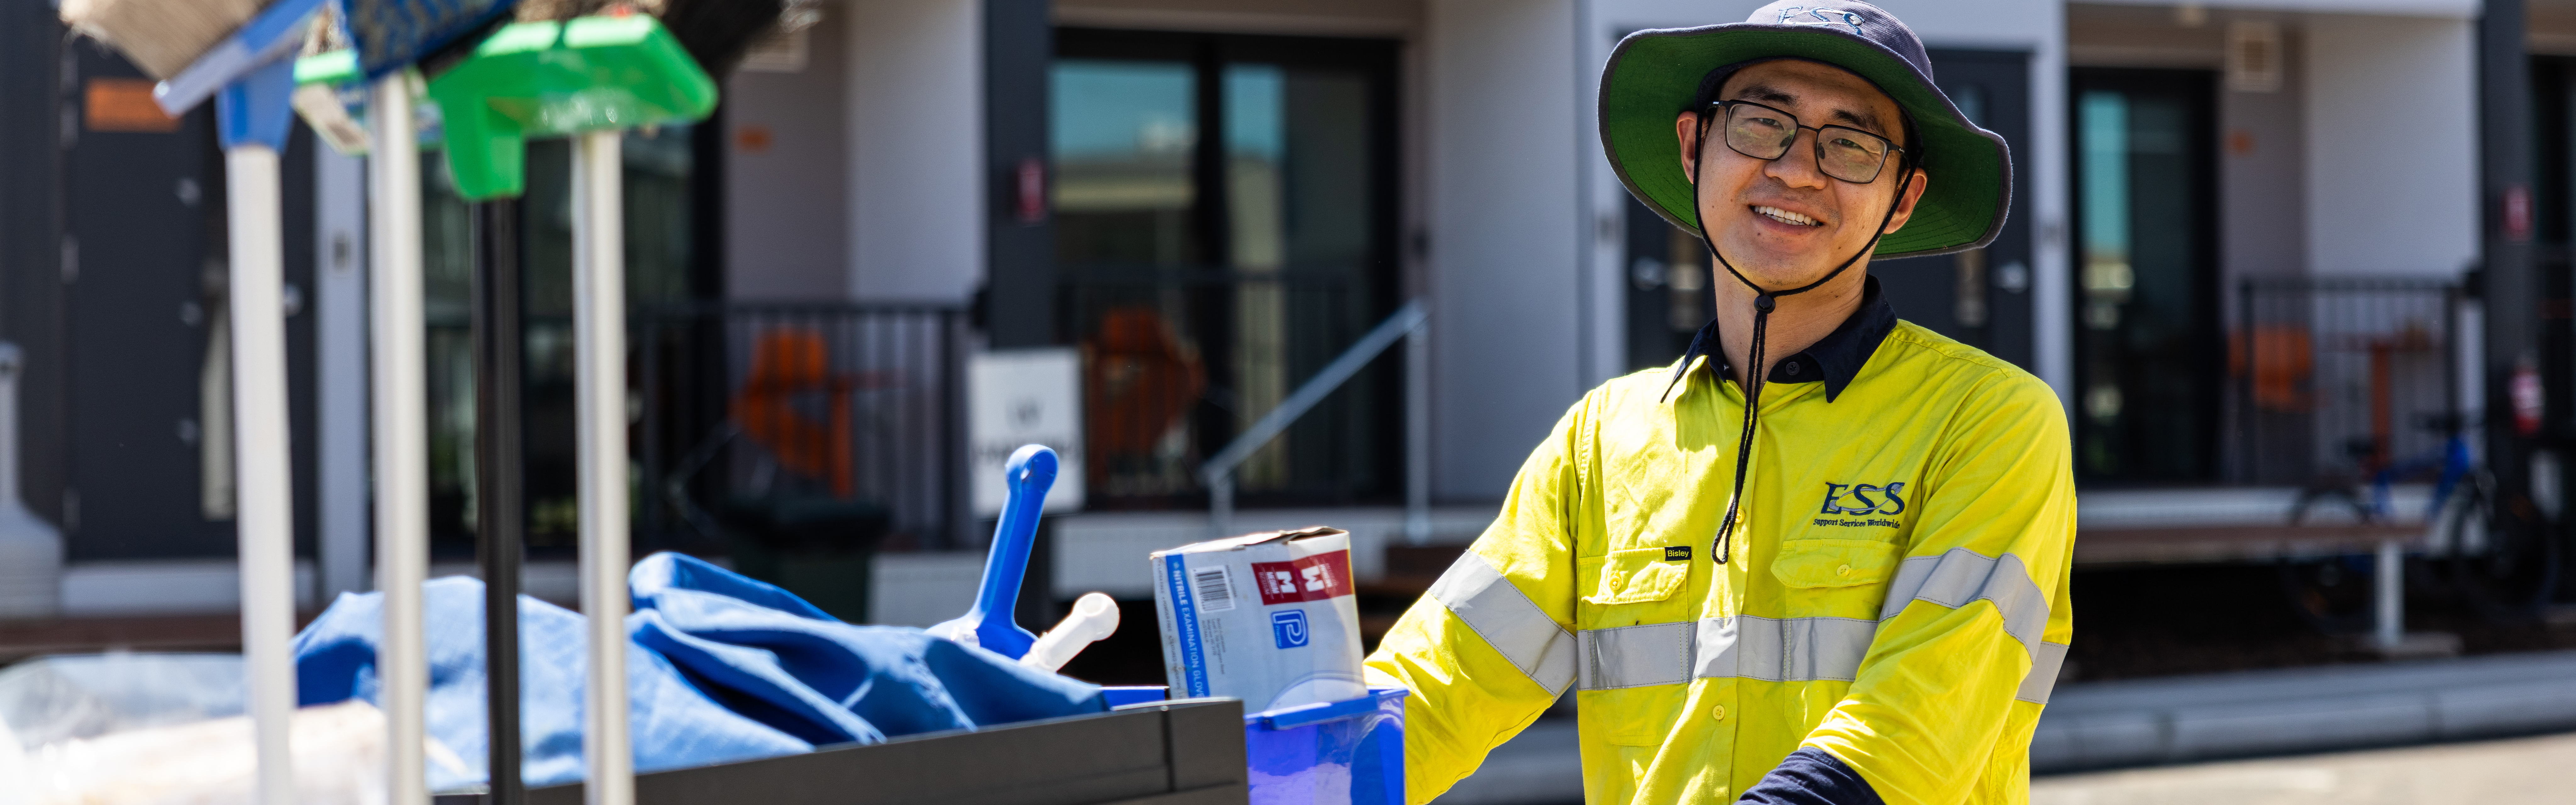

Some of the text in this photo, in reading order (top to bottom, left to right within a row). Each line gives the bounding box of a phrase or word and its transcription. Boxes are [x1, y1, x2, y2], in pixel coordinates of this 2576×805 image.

[1777, 6, 1865, 35] ESS
[1821, 482, 1905, 516] ESS
[1840, 519, 1866, 527] Services
[1868, 519, 1900, 529] Worldwide
[1266, 572, 1280, 595] MEDIUM
[1275, 571, 1297, 593] M
[1301, 565, 1324, 592] M
[1173, 570, 1188, 605] NITRILE
[1182, 608, 1199, 668] EXAMINATION
